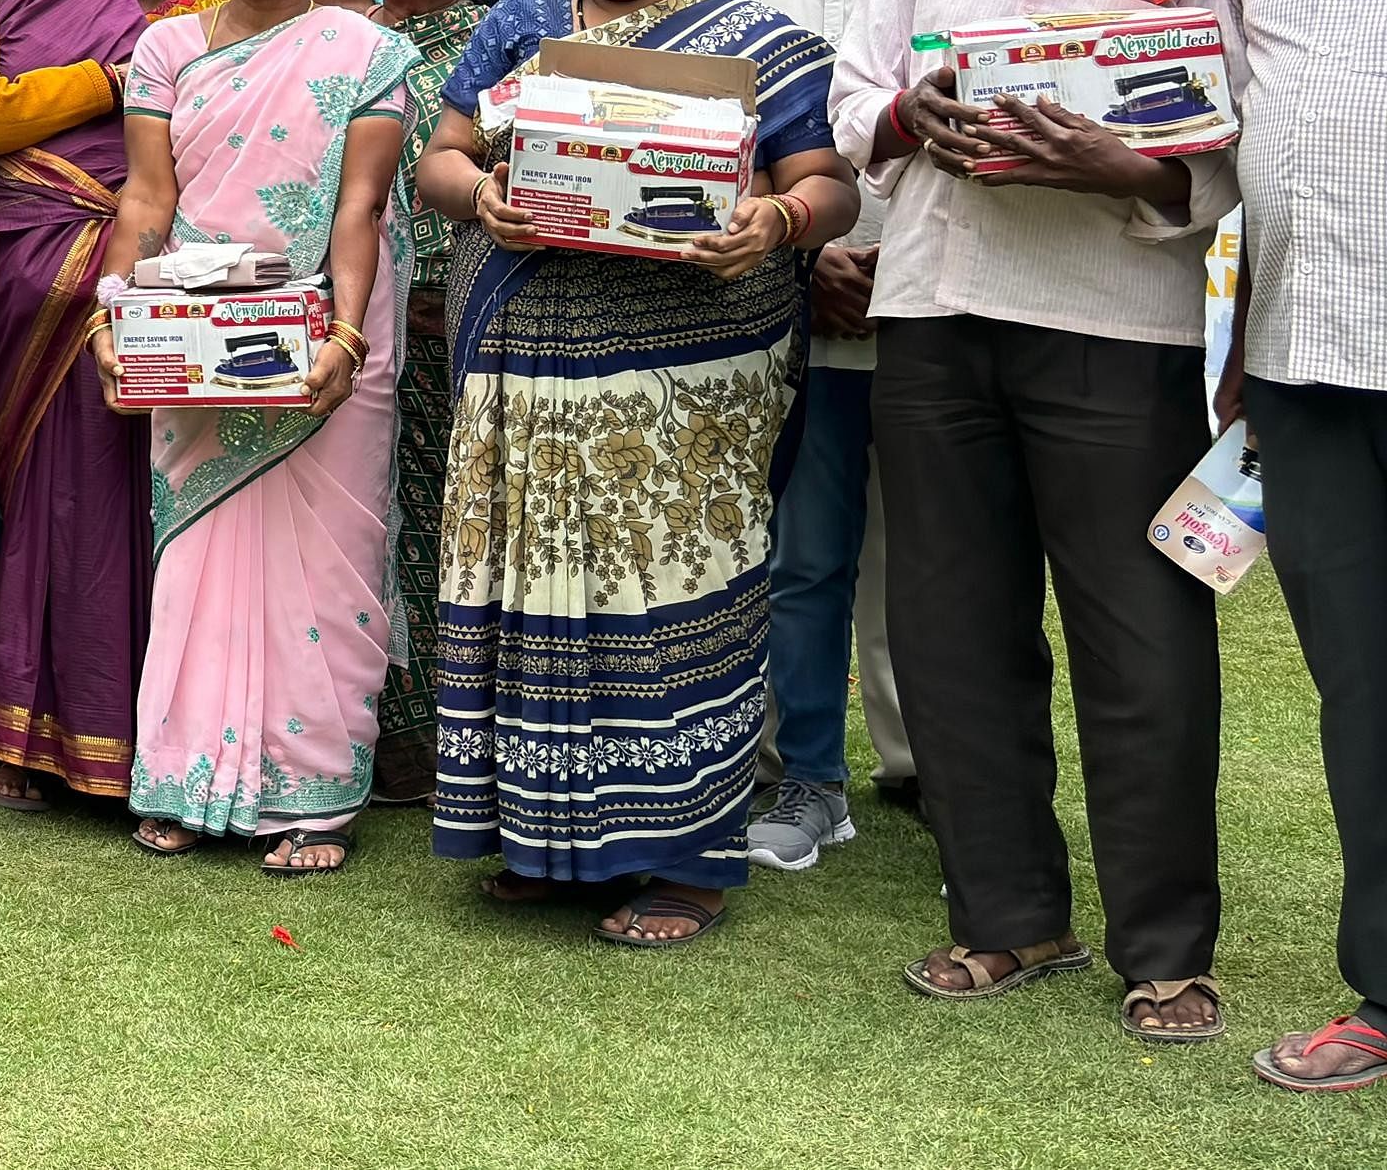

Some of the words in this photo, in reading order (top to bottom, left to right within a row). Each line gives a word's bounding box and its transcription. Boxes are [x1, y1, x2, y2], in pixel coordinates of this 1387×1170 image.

[1107, 30, 1182, 60] Newgold
[1185, 31, 1216, 47] tech
[972, 87, 1003, 96] ENERGY
[1006, 84, 1035, 92] SAVING
[1037, 82, 1056, 90] IRON
[640, 149, 705, 172] Newgold
[707, 159, 734, 172] tech
[522, 170, 547, 178] ENERGY
[549, 172, 573, 182] SAVING
[221, 300, 275, 323] Newgold
[278, 304, 300, 316] tech
[1174, 511, 1241, 558] Newgold
